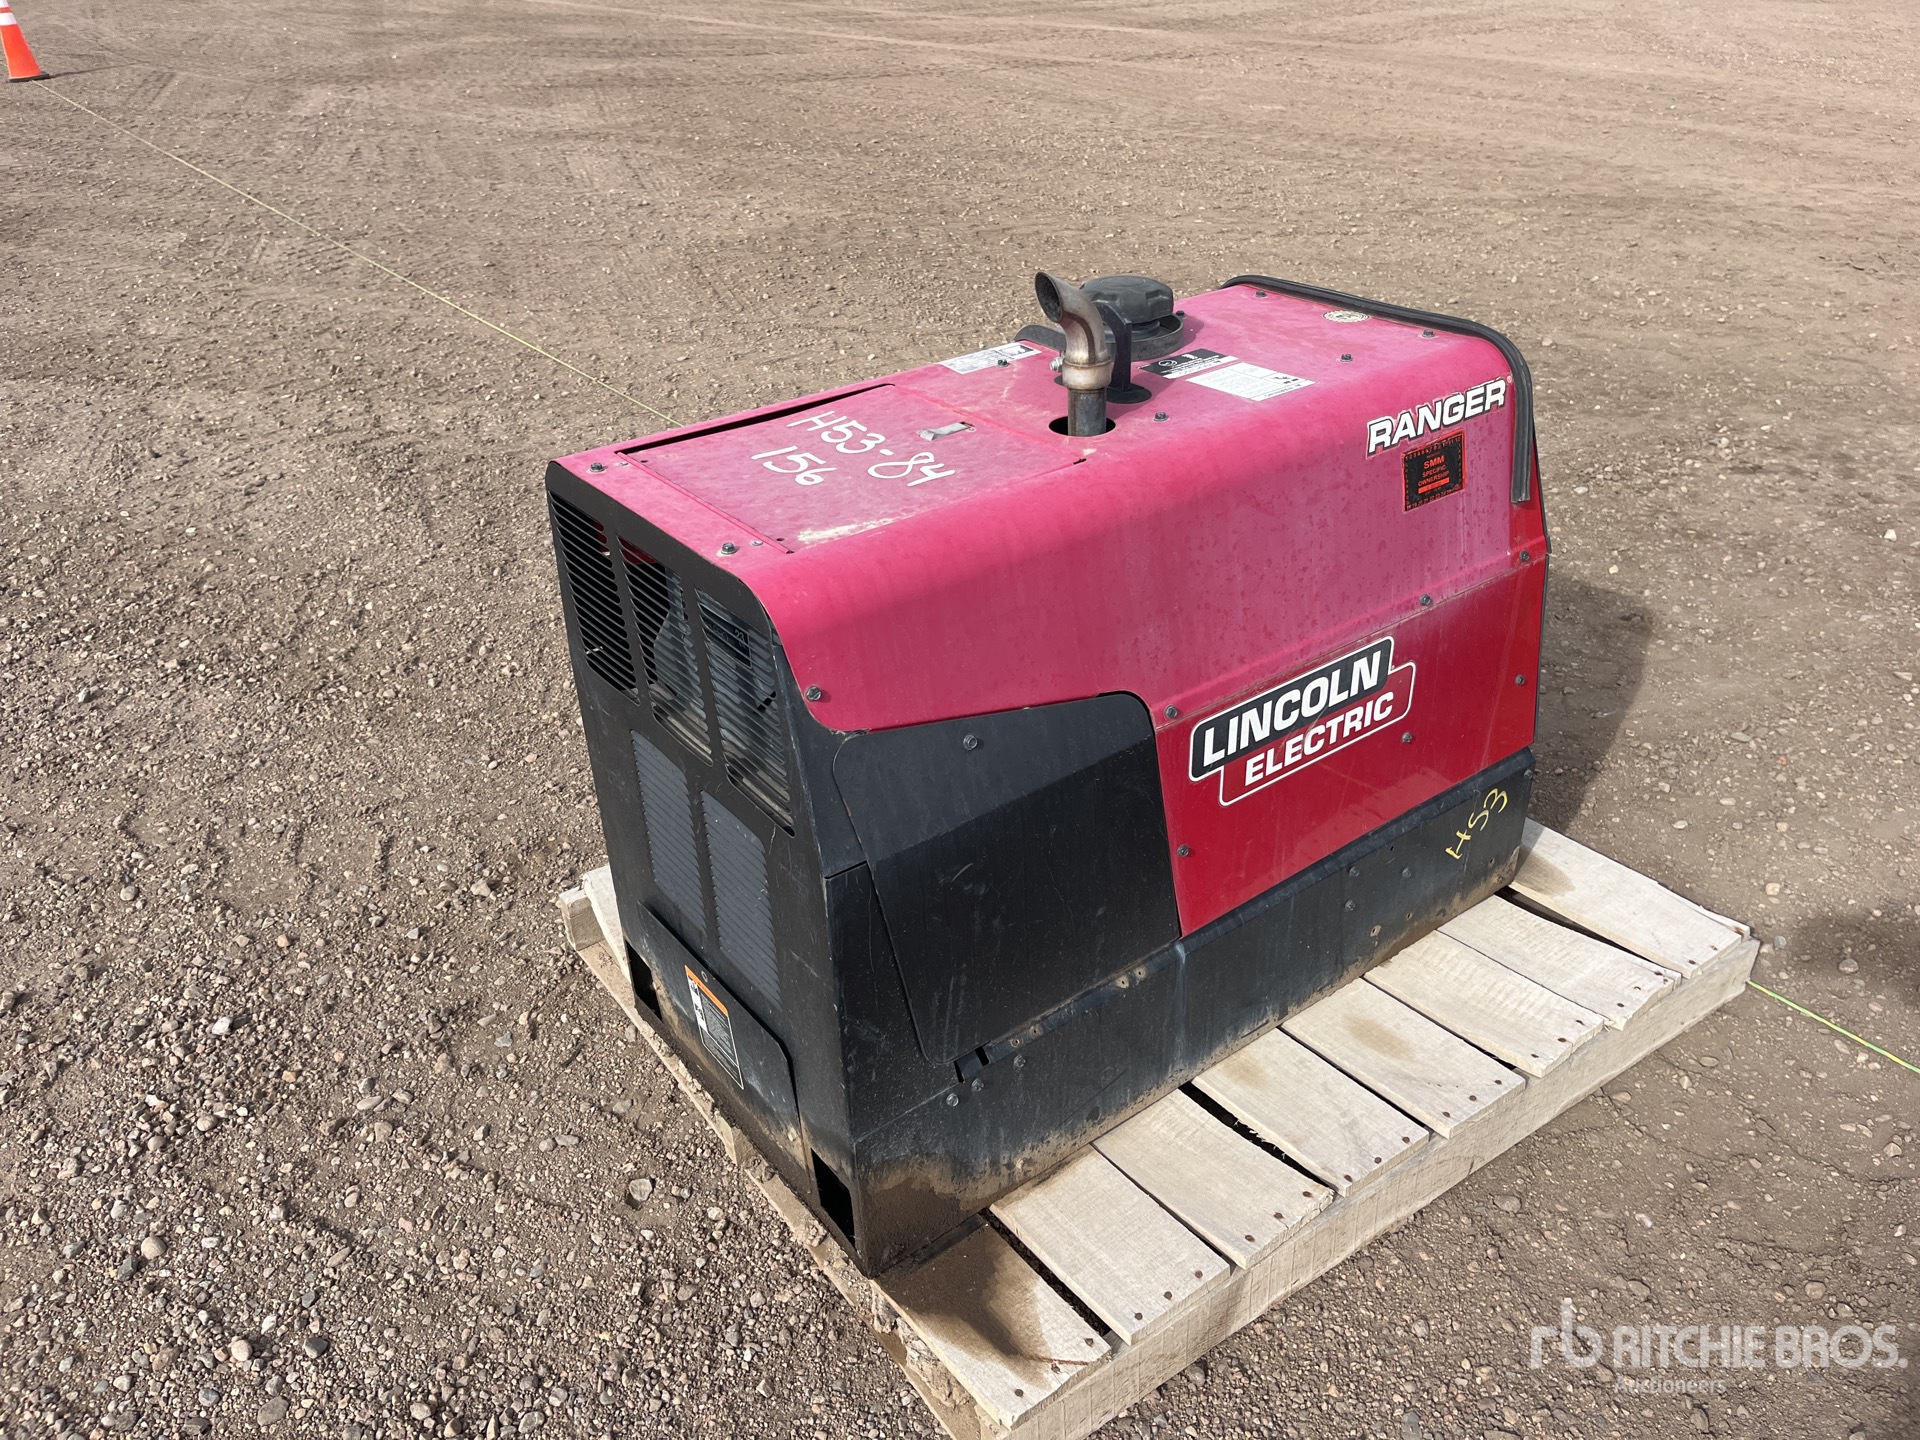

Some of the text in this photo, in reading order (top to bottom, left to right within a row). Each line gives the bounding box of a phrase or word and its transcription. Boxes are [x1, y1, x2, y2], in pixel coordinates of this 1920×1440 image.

[786, 410, 956, 487] H53-84
[1368, 378, 1506, 454] RANGER
[751, 445, 837, 486] 156
[1424, 455, 1445, 469] SMM
[1203, 650, 1382, 767] LINCOLN
[1244, 691, 1395, 787] ELECTRIC
